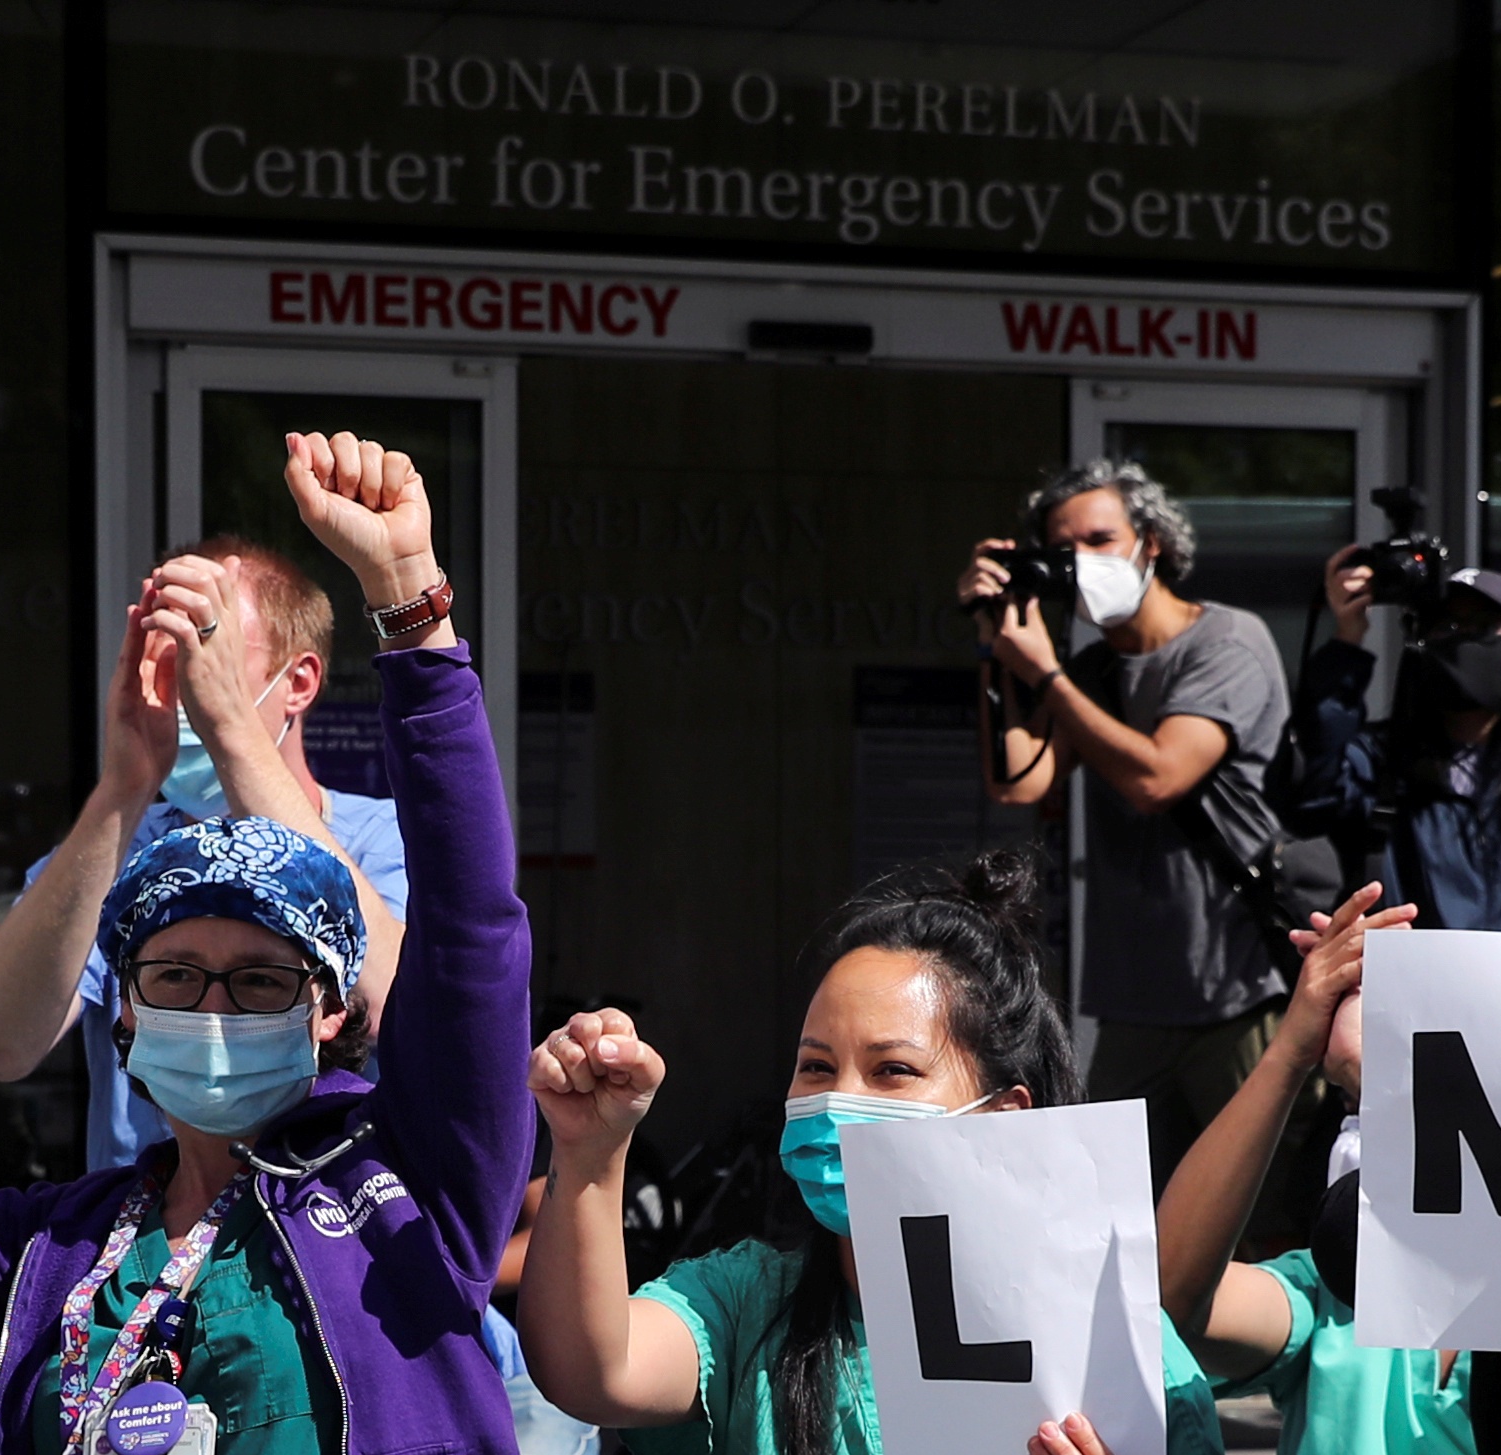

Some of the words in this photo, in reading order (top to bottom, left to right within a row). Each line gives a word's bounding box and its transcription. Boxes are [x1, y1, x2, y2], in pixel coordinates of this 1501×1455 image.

[402, 53, 702, 120] RONALD
[730, 73, 795, 125] O.
[826, 80, 1203, 148] PERELMAN
[188, 125, 464, 203] Center
[490, 138, 600, 212] for
[627, 145, 1060, 250] Emergency
[1085, 170, 1392, 250] Services
[269, 272, 679, 338] EMERGENCY
[1001, 301, 1258, 361] WALK-IN
[314, 1205, 347, 1225] NYU
[343, 1172, 400, 1217] Langone
[900, 1215, 1032, 1382] L
[110, 1406, 131, 1419] Ask
[132, 1406, 150, 1416] me
[150, 1401, 183, 1413] about
[118, 1415, 162, 1430] Comfort
[163, 1413, 172, 1423] 5
